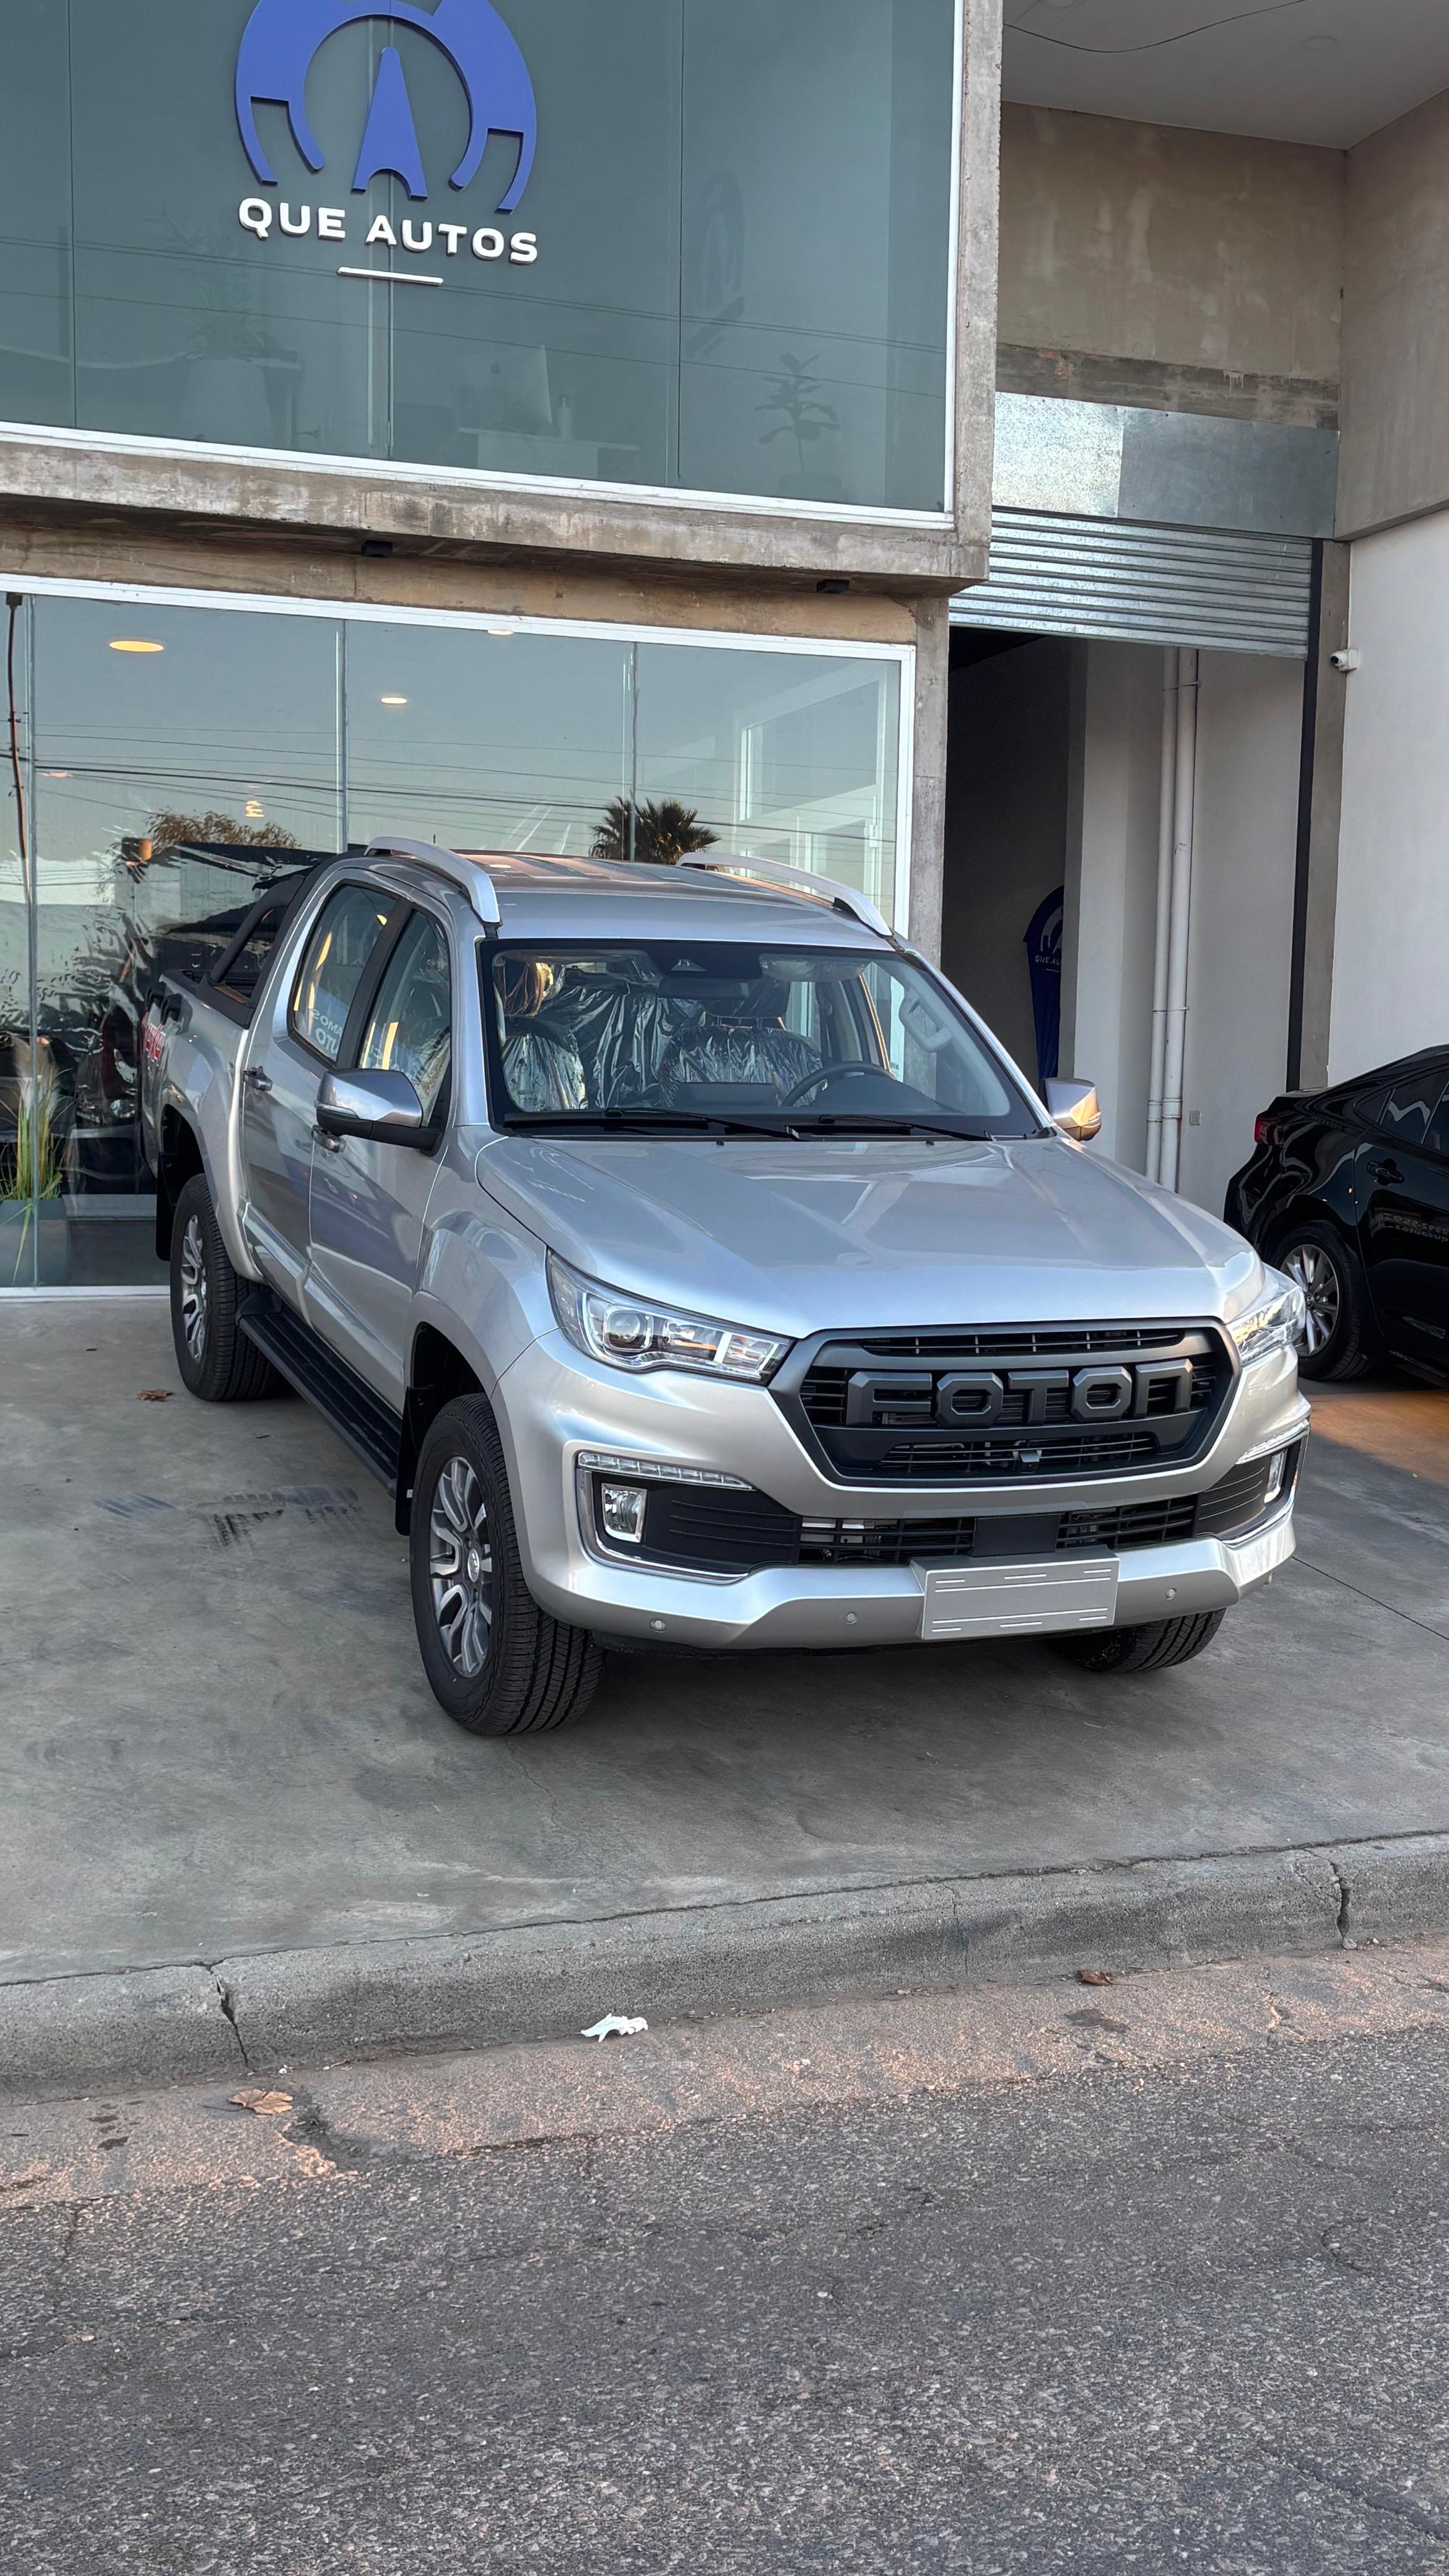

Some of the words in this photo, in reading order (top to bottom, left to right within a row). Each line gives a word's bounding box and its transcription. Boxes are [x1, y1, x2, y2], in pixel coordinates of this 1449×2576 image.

[238, 198, 346, 240] QUE
[365, 215, 538, 265] AUTOS
[1035, 955, 1050, 964] QUE
[846, 1359, 1194, 1426] FOTON
